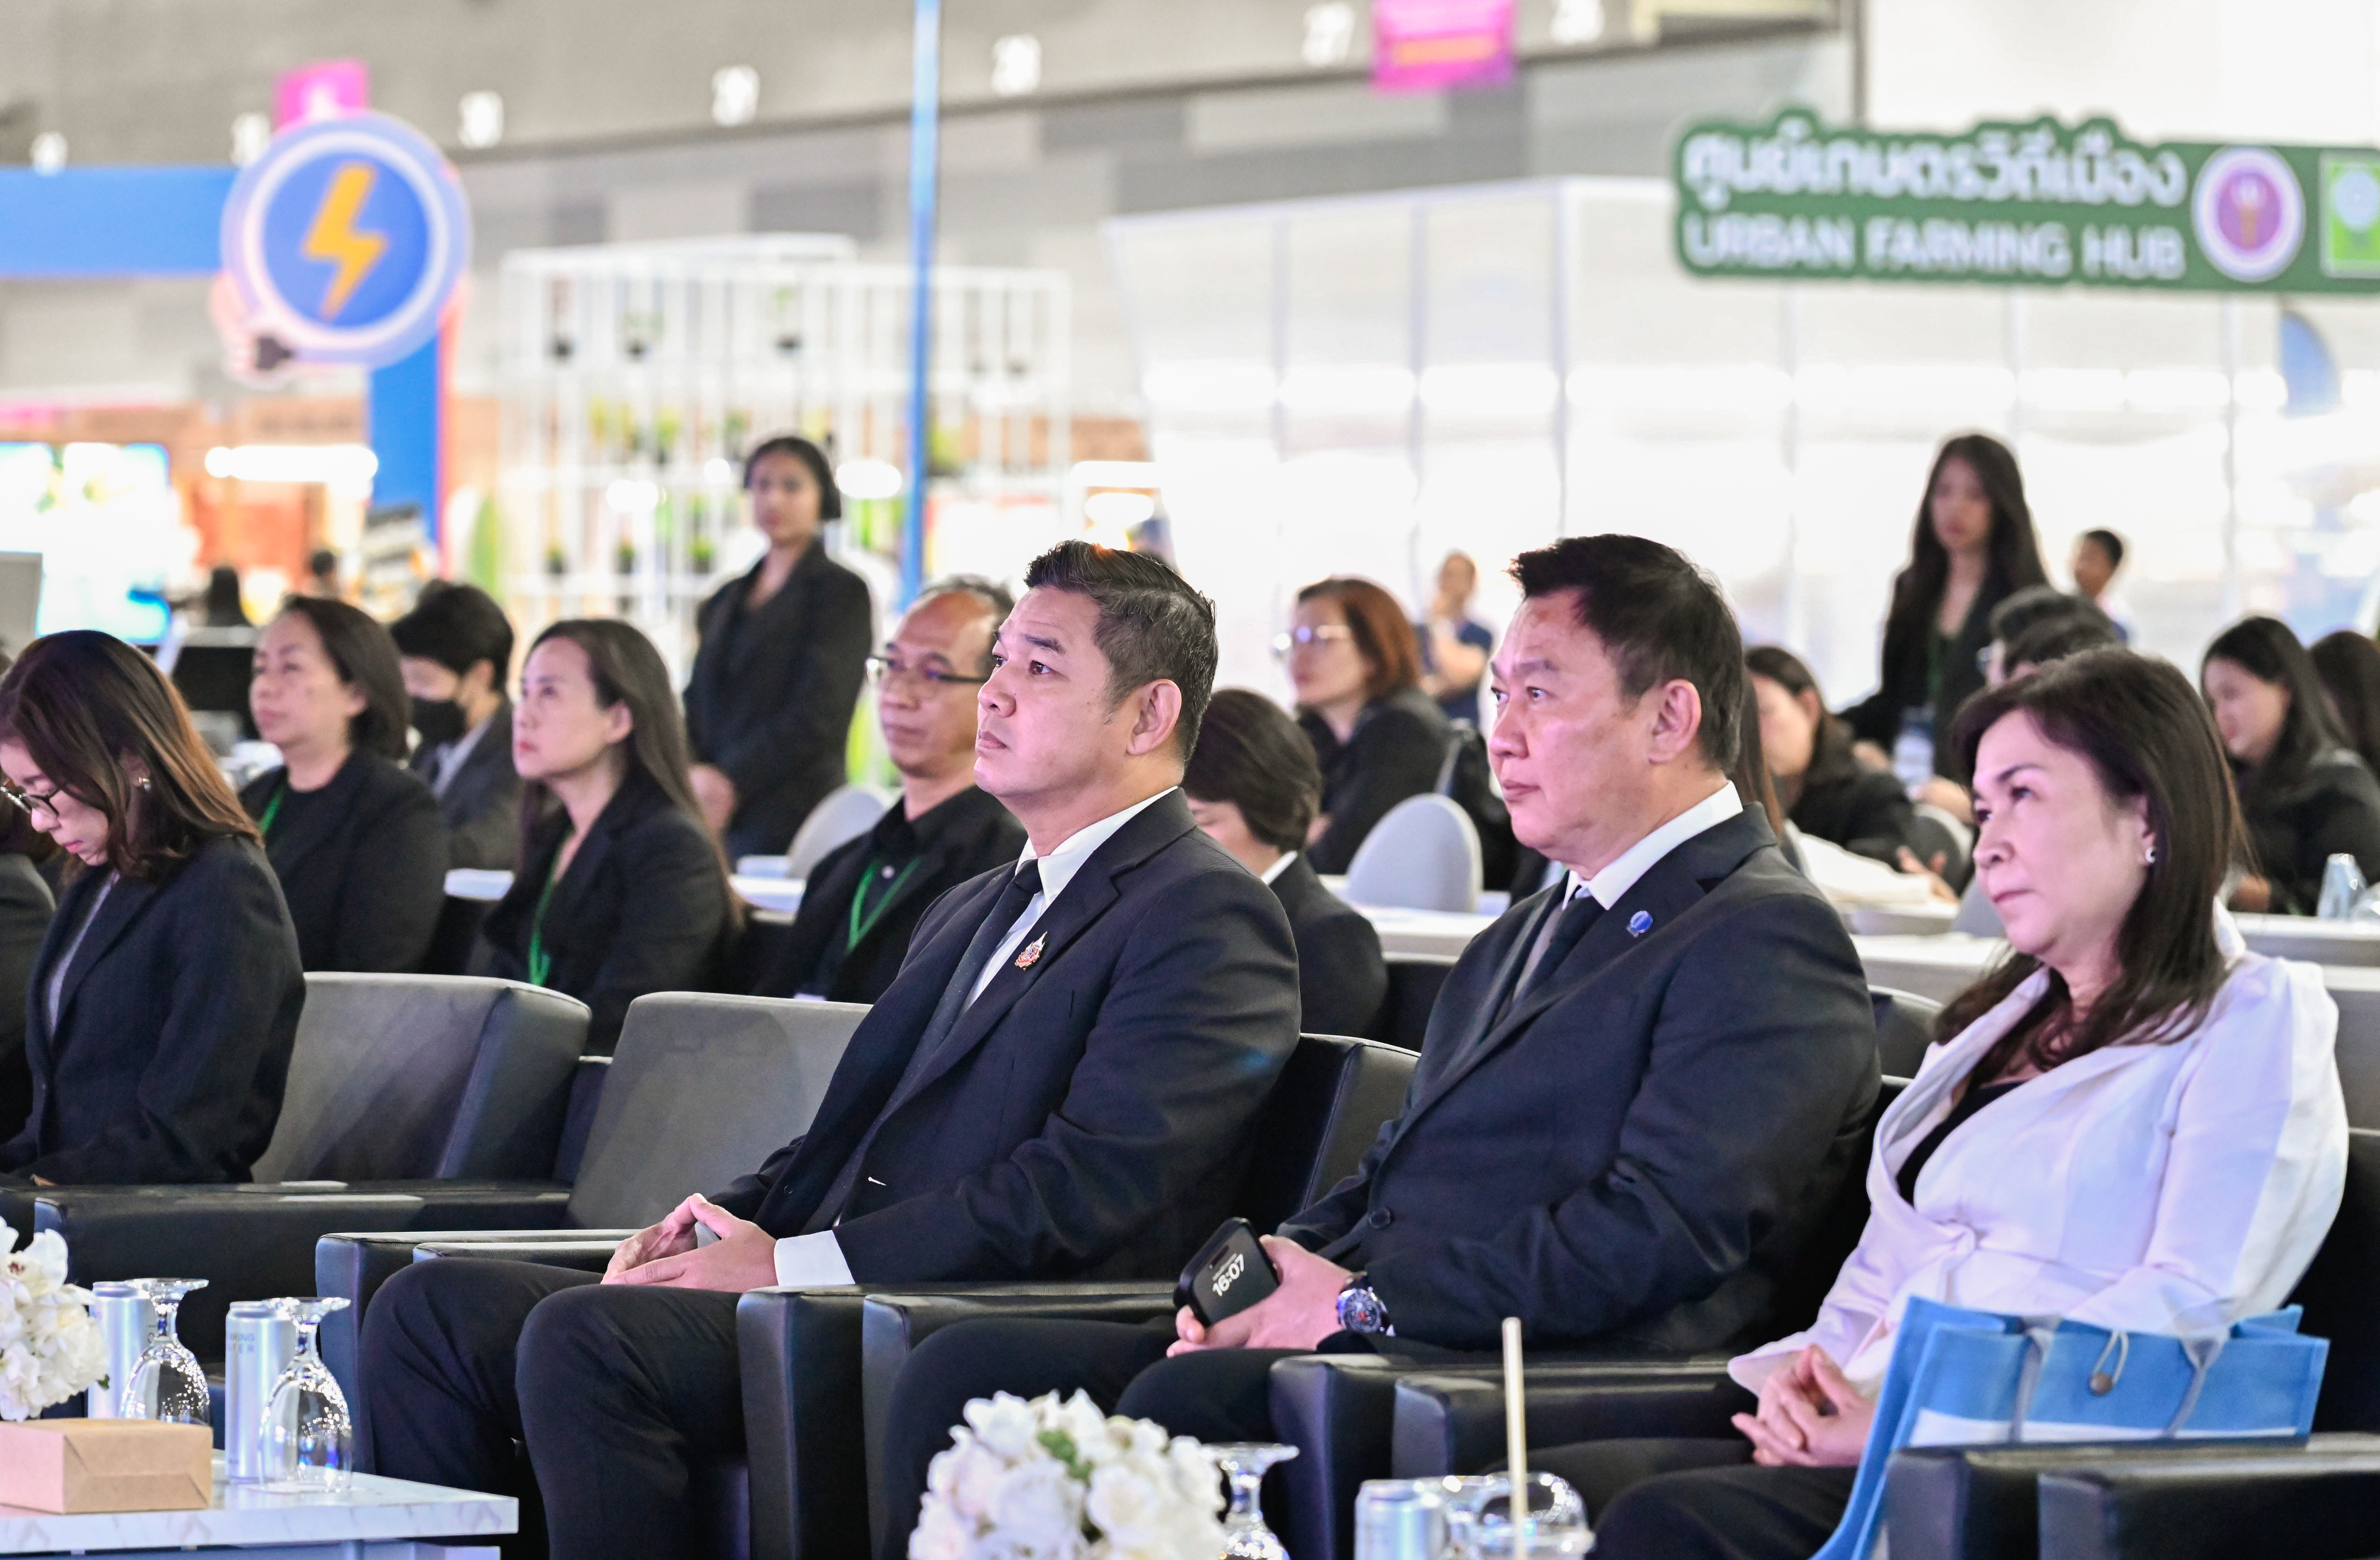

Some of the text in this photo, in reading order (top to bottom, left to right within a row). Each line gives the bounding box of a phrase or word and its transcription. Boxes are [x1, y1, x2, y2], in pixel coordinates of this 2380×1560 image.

[1683, 213, 2186, 280] URBAN FARMING HUB
[1212, 1254, 1244, 1296] 16:07
